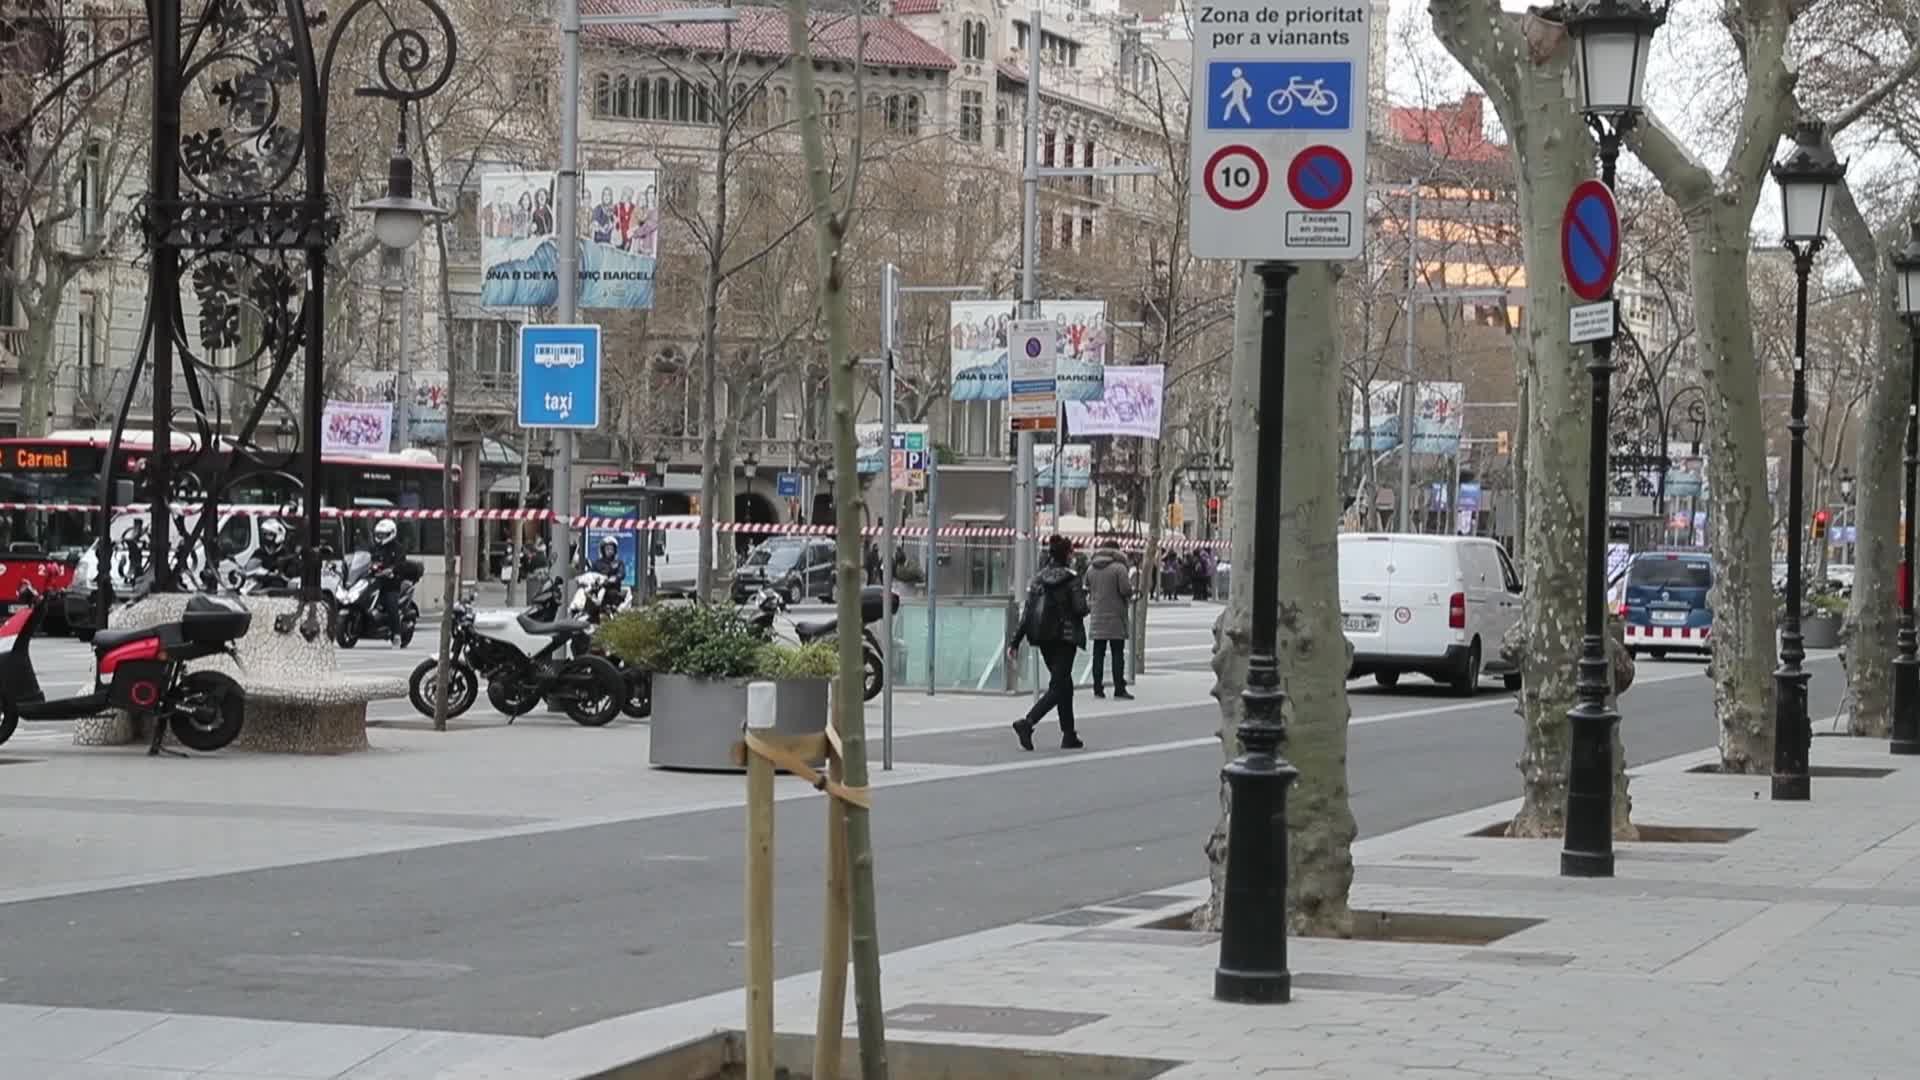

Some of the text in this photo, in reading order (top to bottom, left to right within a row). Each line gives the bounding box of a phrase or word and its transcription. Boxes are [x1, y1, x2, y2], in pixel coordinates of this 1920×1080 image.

[1200, 7, 1363, 26] Zona de prioritat
[1212, 29, 1350, 48] per a vianants
[1222, 166, 1250, 188] 10
[524, 271, 541, 281] DE
[545, 391, 573, 410] taxi
[17, 449, 69, 468] Carmel
[909, 453, 920, 469] P
